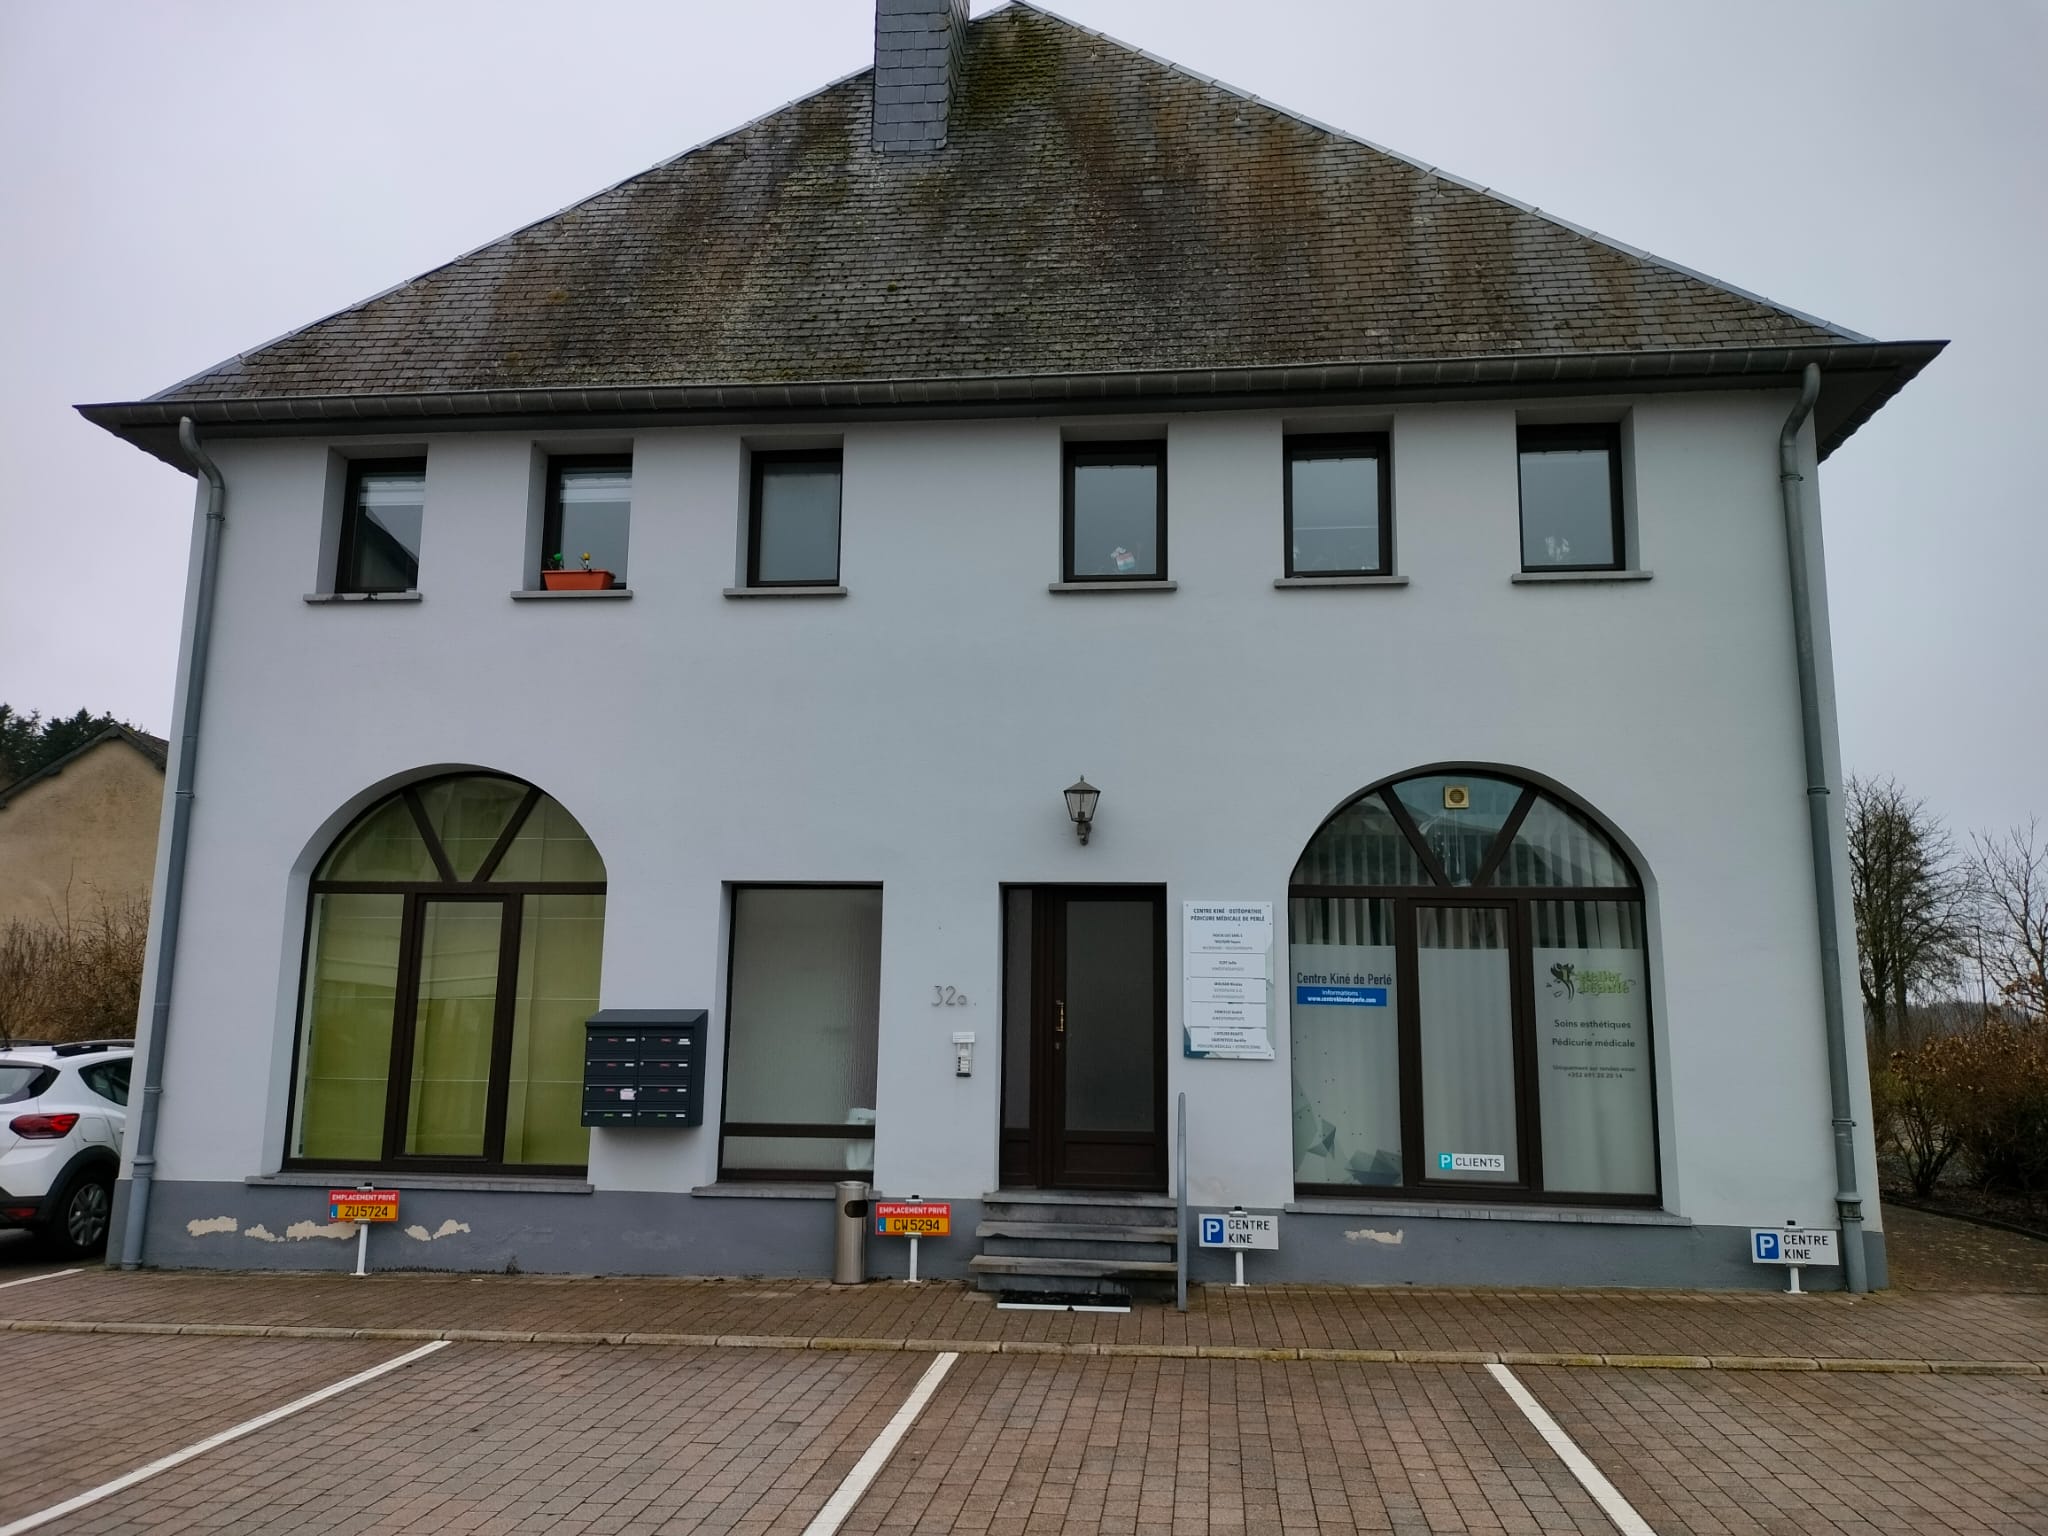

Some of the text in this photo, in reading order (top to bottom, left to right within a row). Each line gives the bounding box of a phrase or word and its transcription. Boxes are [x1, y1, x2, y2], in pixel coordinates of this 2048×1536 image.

[1250, 914, 1265, 922] PERLÉ
[1296, 971, 1393, 986] Centre Kiné de Perlé
[1554, 1020, 1631, 1030] Soins esthétiques
[1552, 1038, 1635, 1047] Pédicurie médicale
[1455, 1157, 1501, 1168] CLIENTS
[332, 1192, 396, 1201] EMPLACEMENT PRIVÉ
[344, 1205, 388, 1217] ZU5724
[879, 1205, 947, 1214] EMPLACEMENT PRIVÉ
[893, 1219, 940, 1231] CW5294
[1228, 1219, 1270, 1231] CENTRE
[1228, 1233, 1253, 1244] KINE
[1783, 1234, 1829, 1246] CENTRE
[1784, 1248, 1812, 1260] KINE
